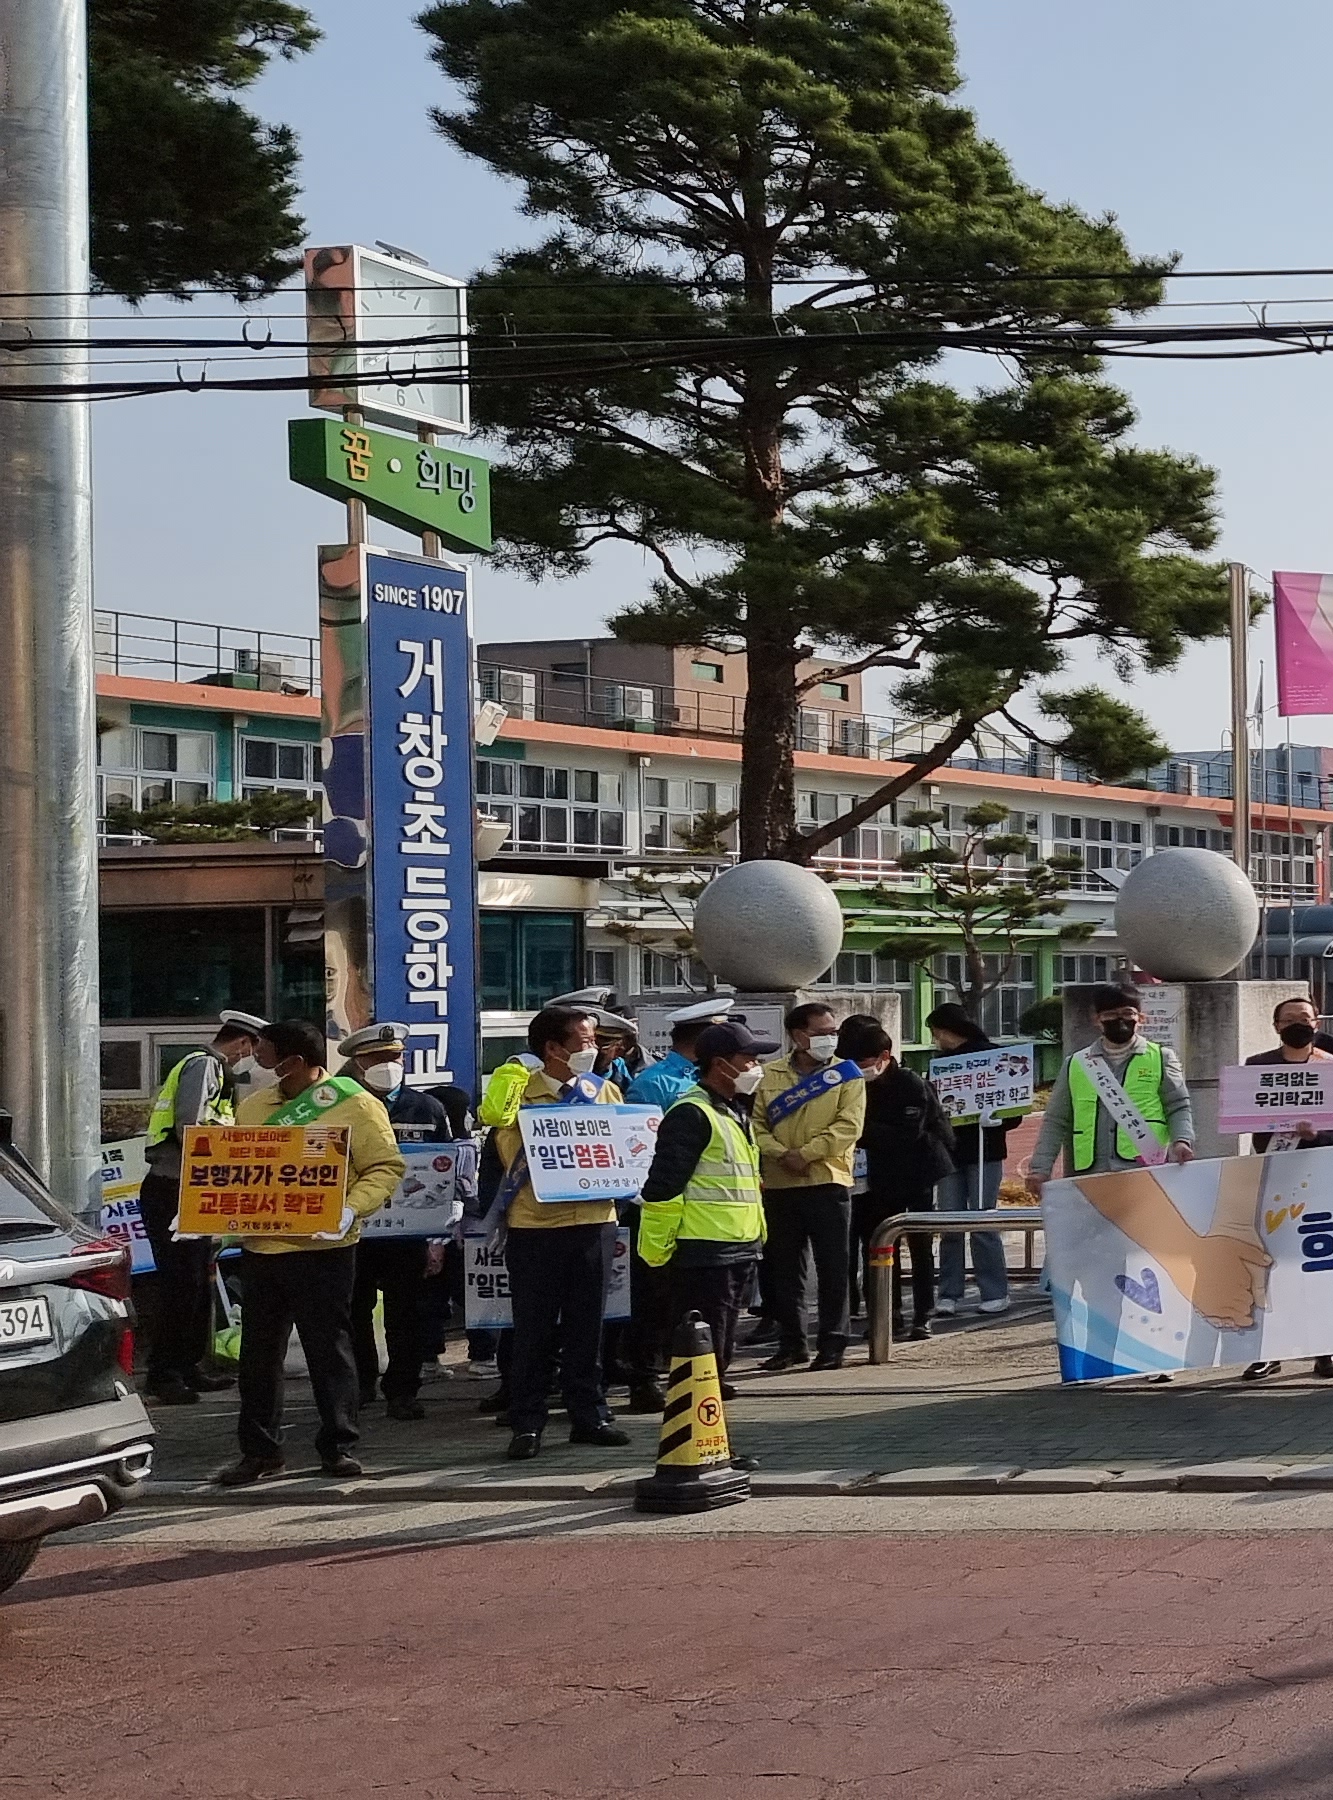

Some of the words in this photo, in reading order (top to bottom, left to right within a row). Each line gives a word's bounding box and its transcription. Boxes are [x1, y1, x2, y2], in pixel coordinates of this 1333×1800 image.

[397, 388, 406, 406] 6
[342, 428, 374, 482] 꿈
[415, 449, 478, 514] 희망
[374, 582, 418, 608] SINCE
[421, 584, 466, 615] 1907
[397, 639, 454, 1090] 거창초등학교
[1259, 1071, 1320, 1088] 폭력없는
[974, 1089, 1006, 1110] 행복한
[1008, 1085, 1031, 1104] 학교
[1254, 1089, 1324, 1108] 우리학교!!
[532, 1118, 573, 1138] 사람이
[575, 1119, 612, 1137] 보이면
[189, 1164, 273, 1187] 보행자가
[278, 1164, 338, 1187] 우선인
[199, 1193, 278, 1215] 교통질서
[283, 1193, 324, 1215] 확립
[0, 1304, 44, 1337] 394
